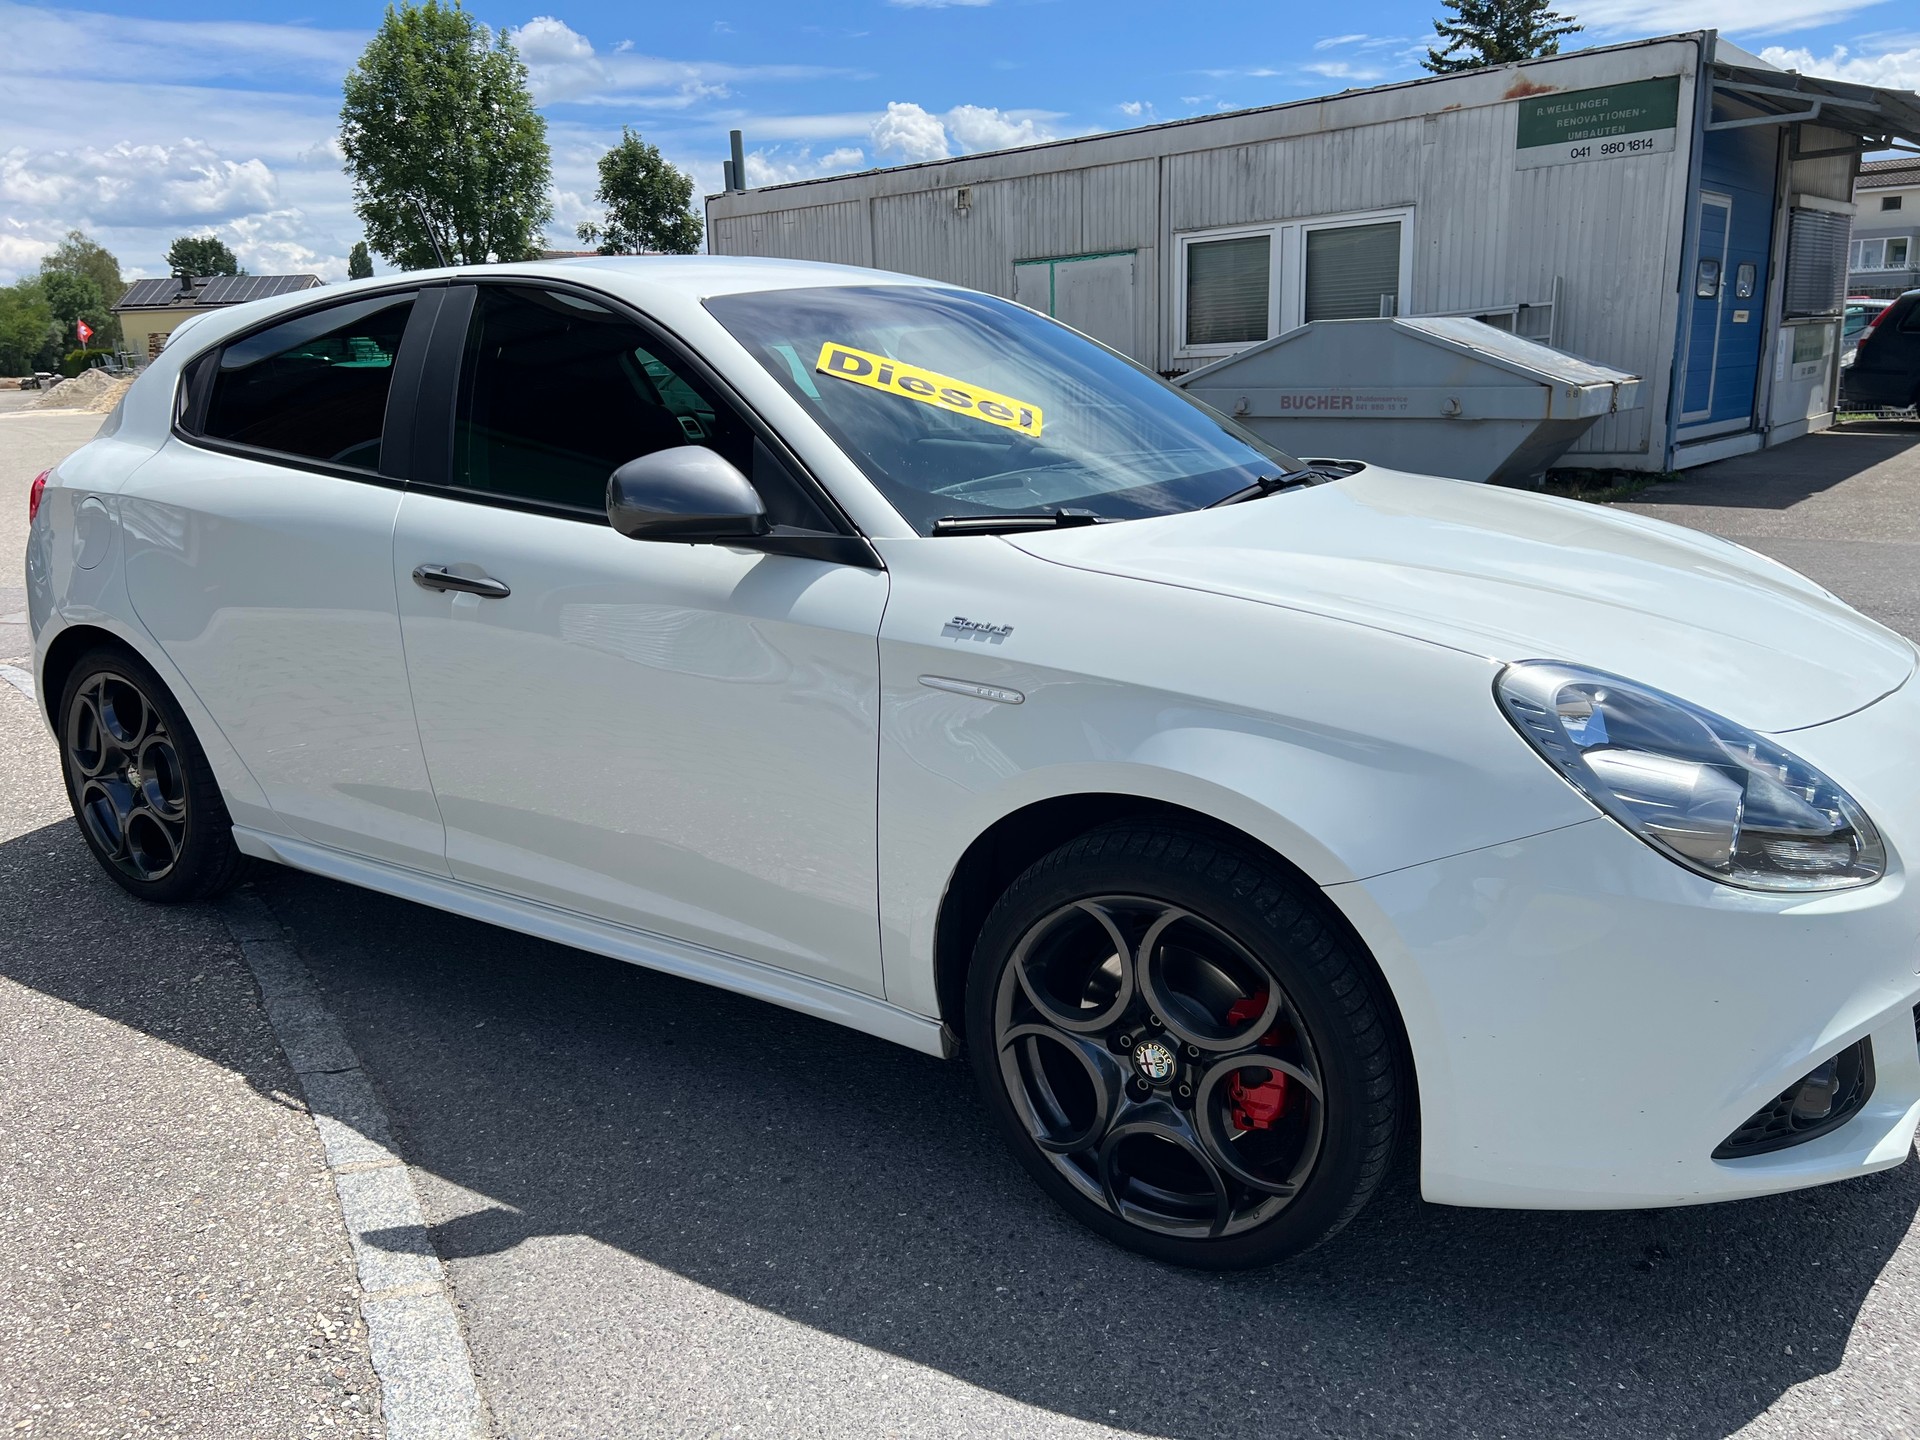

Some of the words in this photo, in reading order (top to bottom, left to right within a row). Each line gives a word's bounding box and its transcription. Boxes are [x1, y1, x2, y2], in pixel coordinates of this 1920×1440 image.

[1547, 98, 1609, 114] WELLINGER
[1567, 125, 1626, 141] UMBAUTEN
[1570, 146, 1591, 159] 041
[827, 350, 1033, 430] Diesel
[1280, 395, 1354, 410] BUCHER
[944, 616, 1014, 637] Sprint
